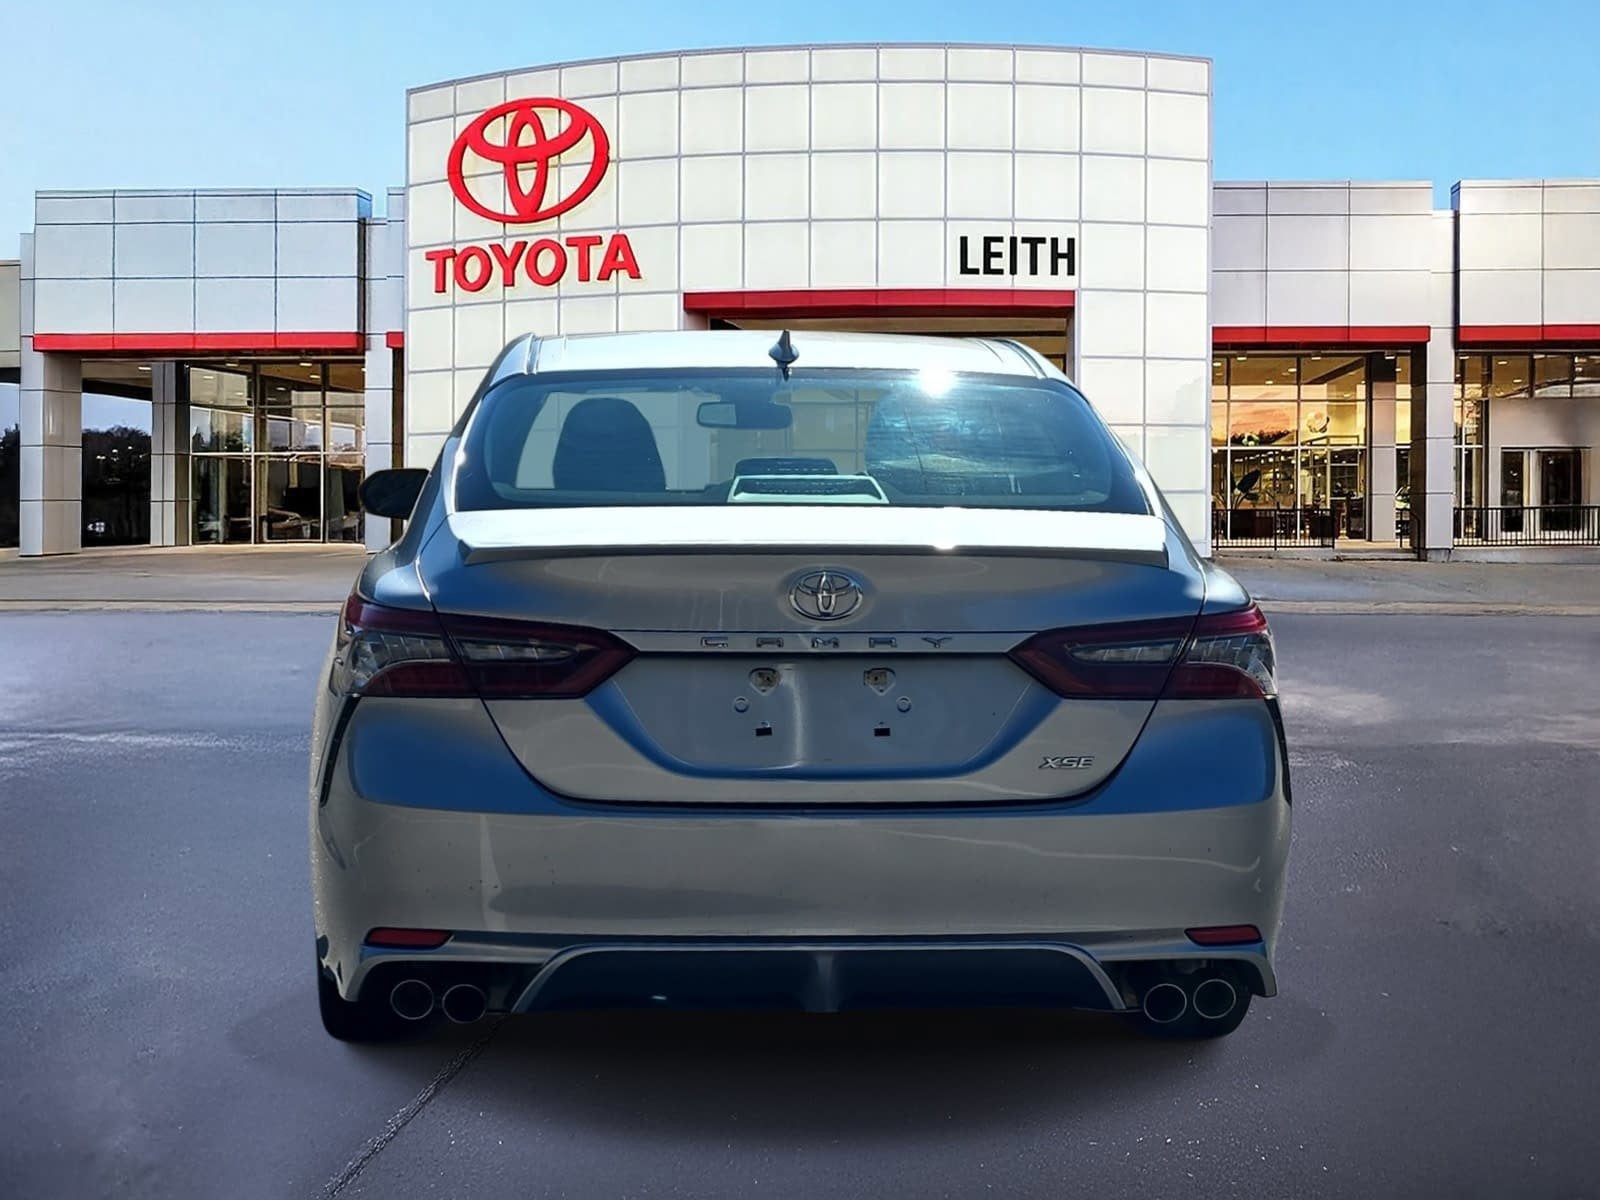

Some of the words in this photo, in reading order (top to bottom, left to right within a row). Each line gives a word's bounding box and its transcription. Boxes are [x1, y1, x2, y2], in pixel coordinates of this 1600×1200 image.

[425, 233, 641, 294] TOYOTA
[958, 235, 1076, 276] LEITH
[700, 636, 953, 649] CAMRY
[1038, 756, 1095, 770] XSE
